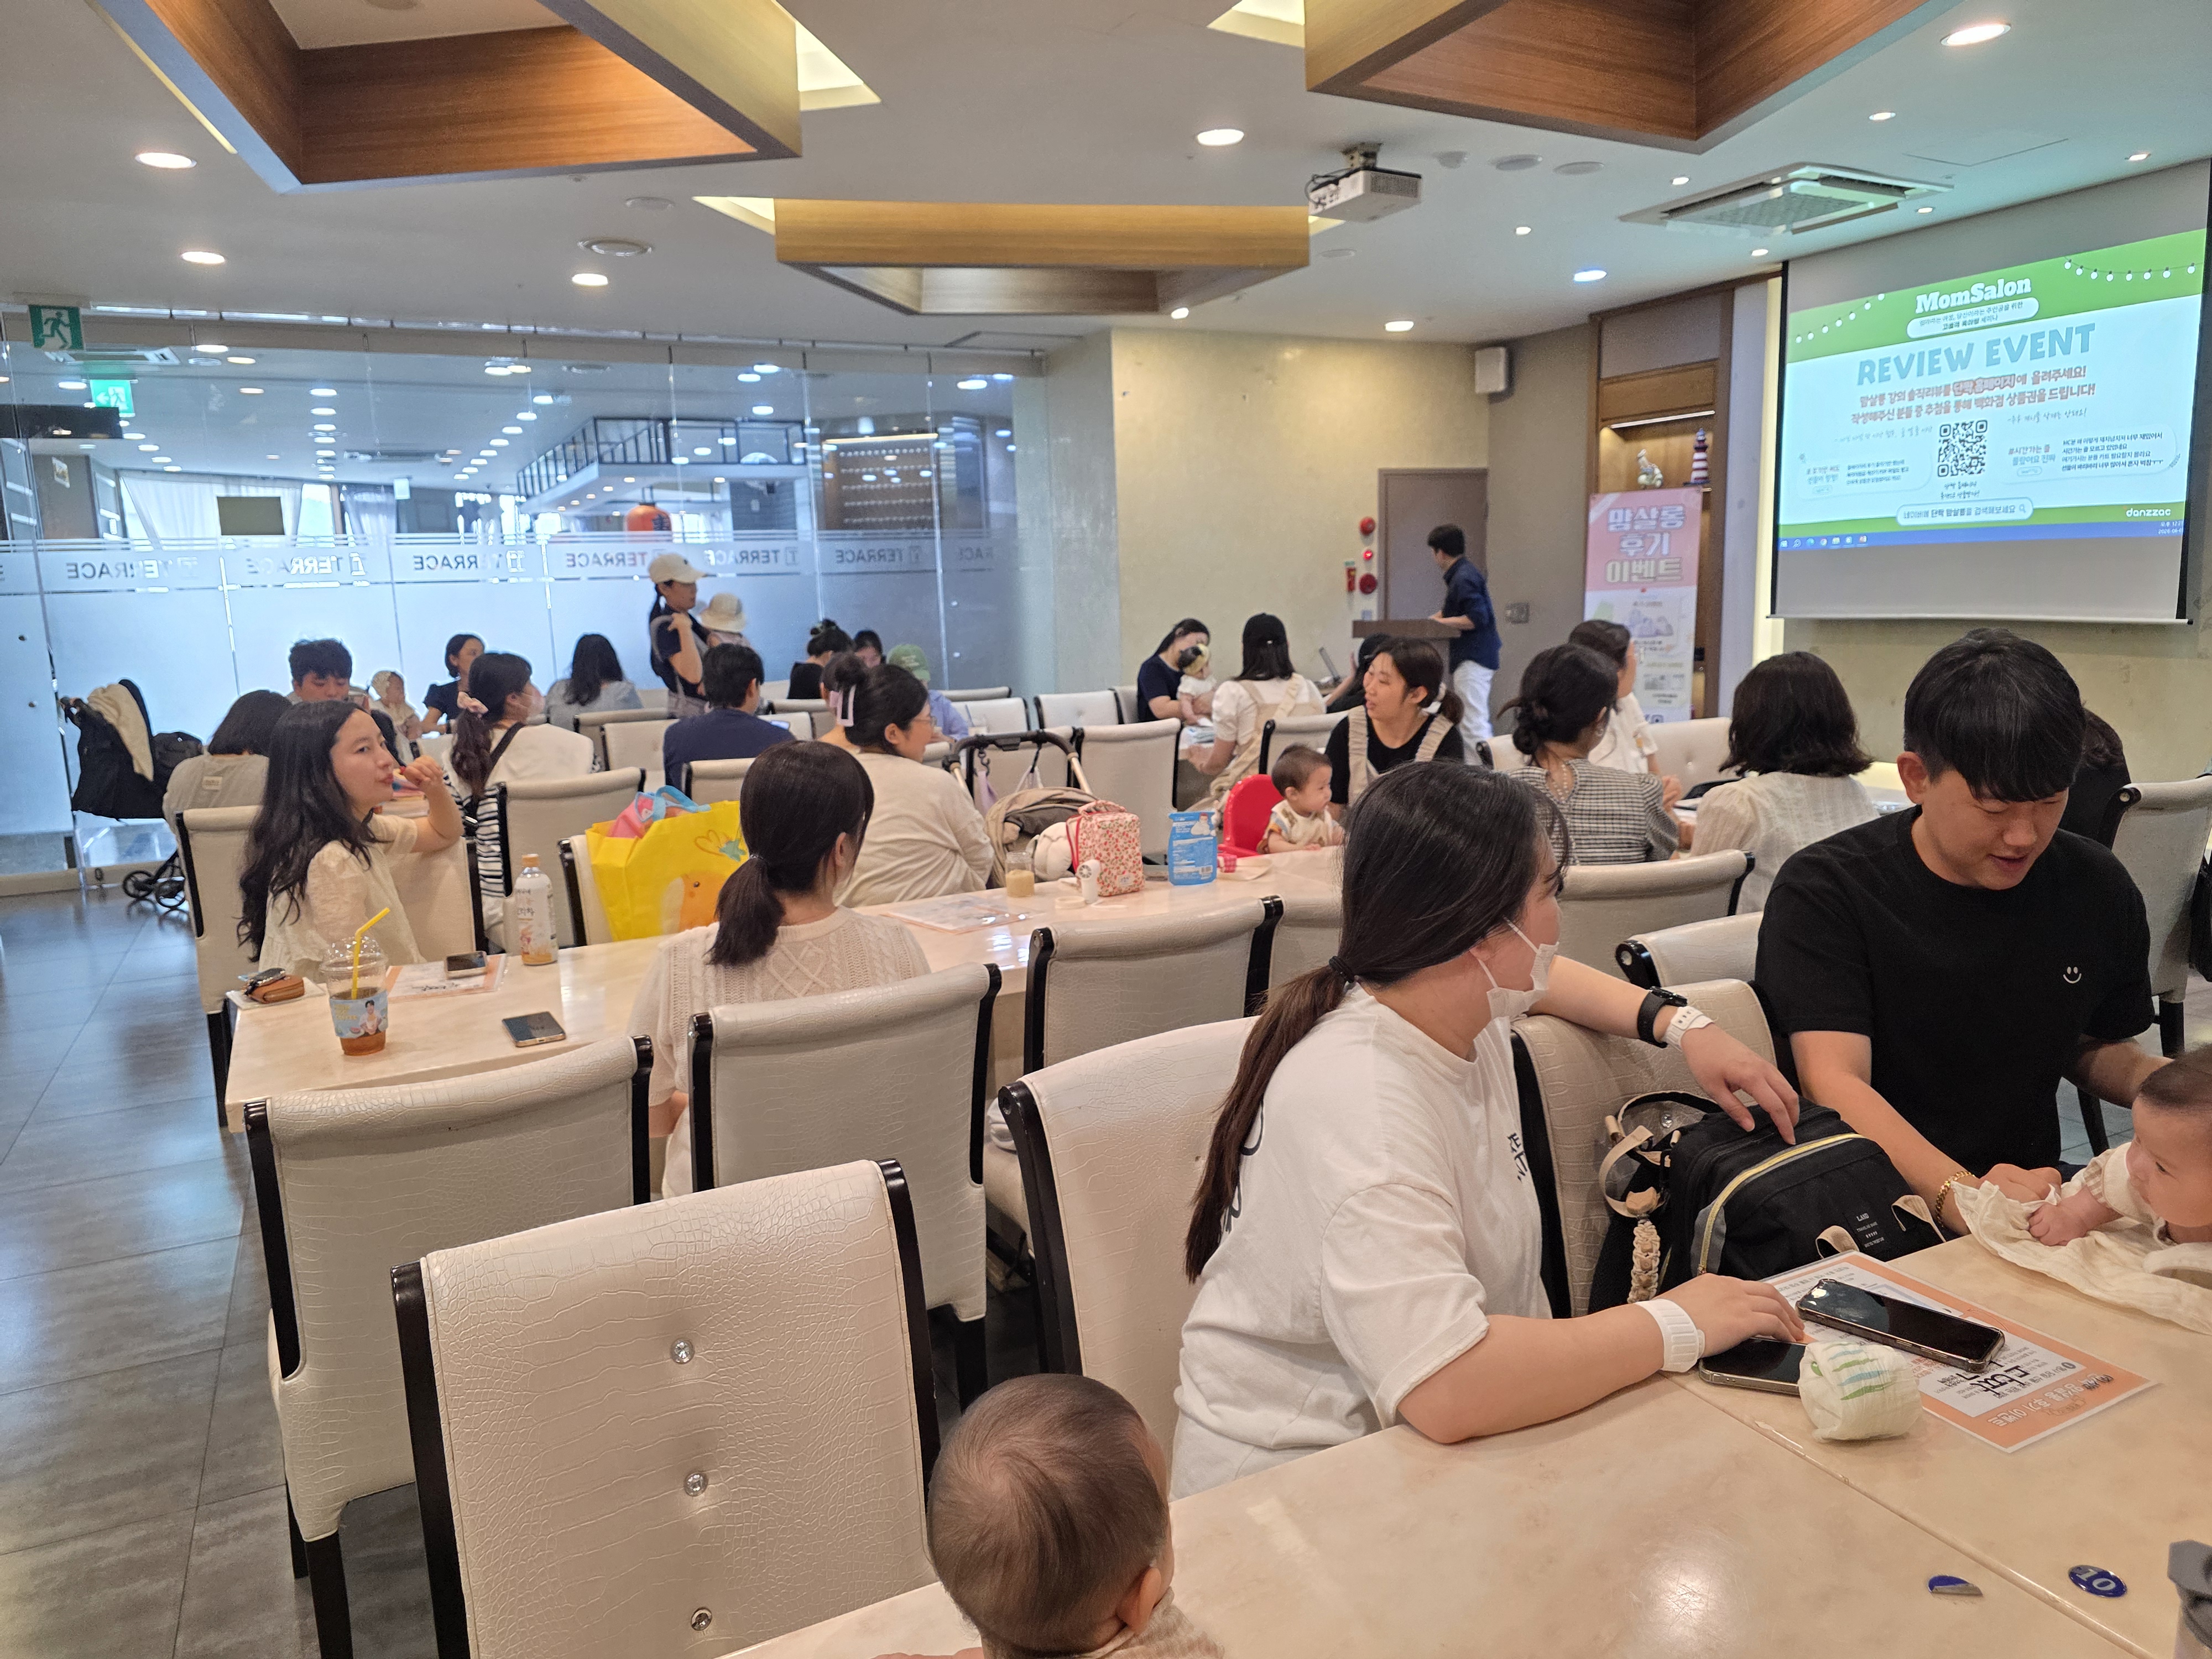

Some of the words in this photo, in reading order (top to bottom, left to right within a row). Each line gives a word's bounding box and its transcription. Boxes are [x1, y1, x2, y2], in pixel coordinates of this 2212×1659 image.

[1915, 278, 2031, 314] MomSalon
[2011, 301, 2023, 310] 위한
[1857, 342, 1974, 385] REVIEW
[1985, 323, 2096, 367] EVENT
[1888, 390, 1906, 404] 강의
[1908, 384, 1951, 401] 솔직리뷰를
[1974, 373, 2027, 395] 홈페이지에
[2032, 366, 2086, 385] 올려주세요!
[1851, 408, 1895, 424] 작성해주신
[1897, 405, 1912, 419] 분들
[1915, 404, 1923, 418] 중
[1925, 400, 1950, 415] 추첨을
[1954, 398, 1972, 413] 통해
[1974, 394, 2004, 409] 백화점
[2006, 388, 2046, 406] 상품권을
[2048, 383, 2096, 400] 드립니다!
[2127, 433, 2138, 442] 너무
[2099, 461, 2109, 470] 너무
[1608, 504, 1686, 532] 맘살롱
[2126, 508, 2171, 517] danzzac
[1620, 532, 1670, 556] 후기
[1606, 557, 1682, 583] 이벤트
[1856, 1213, 1869, 1222] LAND
[2021, 1397, 2051, 1412] 후기
[1987, 1408, 2028, 1427] 이벤트
[2076, 1569, 2116, 1591] 10
